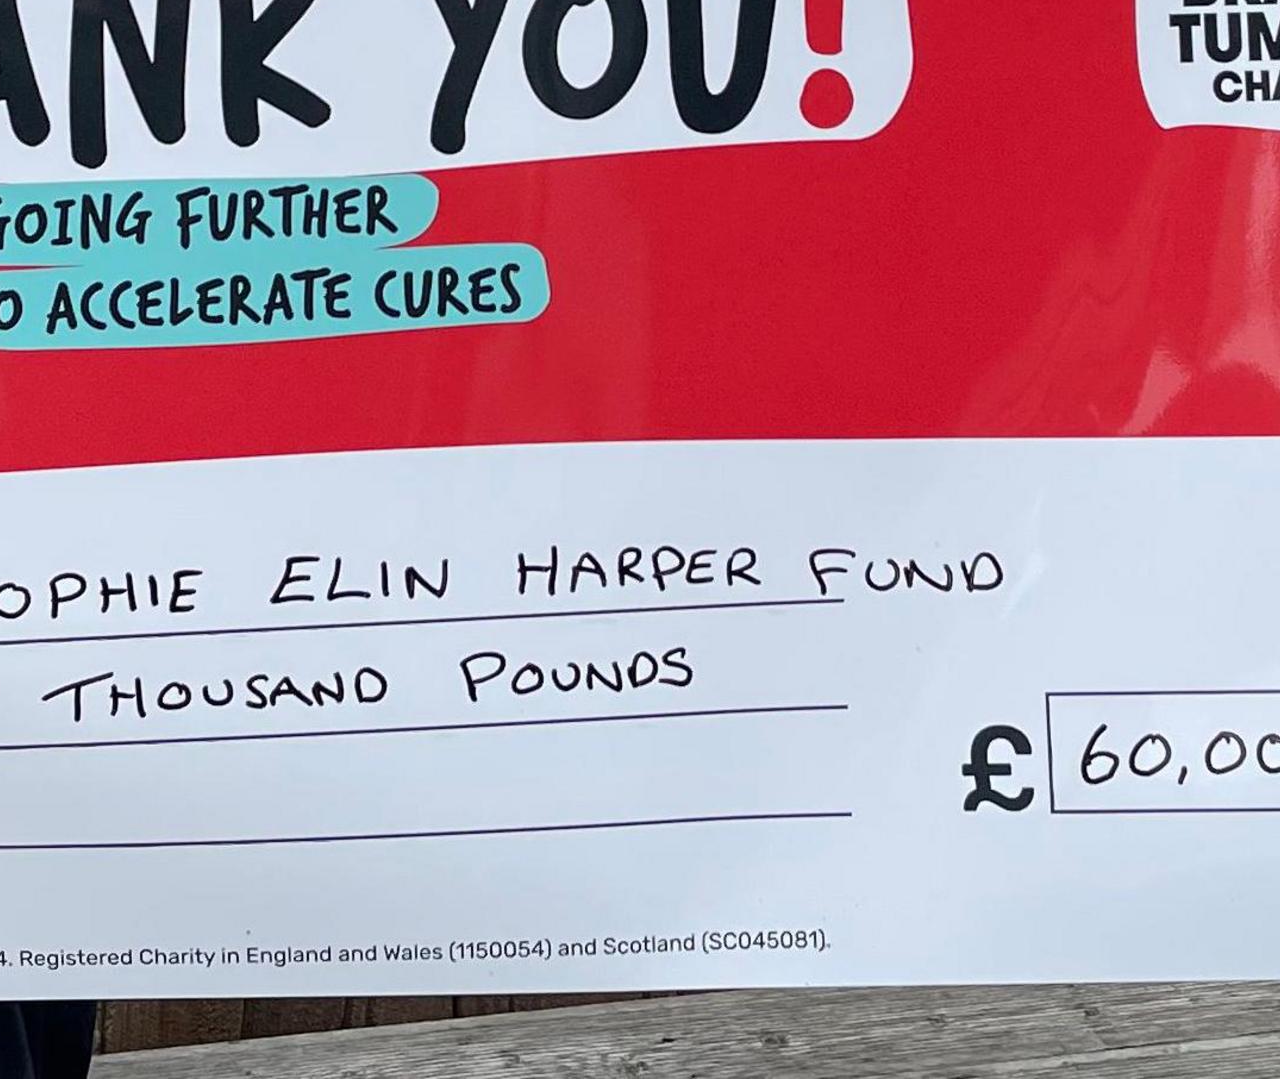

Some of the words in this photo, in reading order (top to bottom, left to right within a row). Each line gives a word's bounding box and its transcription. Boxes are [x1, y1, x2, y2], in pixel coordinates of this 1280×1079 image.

[175, 183, 399, 249] FURTHER
[45, 265, 352, 335] ACCELERATE
[374, 263, 522, 315] CURES
[269, 556, 448, 604] ELIN
[517, 545, 761, 596] HARPER
[809, 548, 1004, 596] FUND
[41, 670, 388, 723] THOUSAND
[459, 647, 693, 703] POUNDS
[961, 724, 1035, 812] £
[19, 949, 133, 971] Registered
[139, 948, 216, 969] Charity
[221, 947, 240, 965] in
[246, 946, 332, 968] England
[338, 945, 377, 963] and
[383, 944, 443, 961] Wales
[449, 938, 552, 963] (1150054)
[557, 938, 597, 957] and
[603, 935, 695, 955] Scotland
[702, 929, 832, 954] (SC045081).
